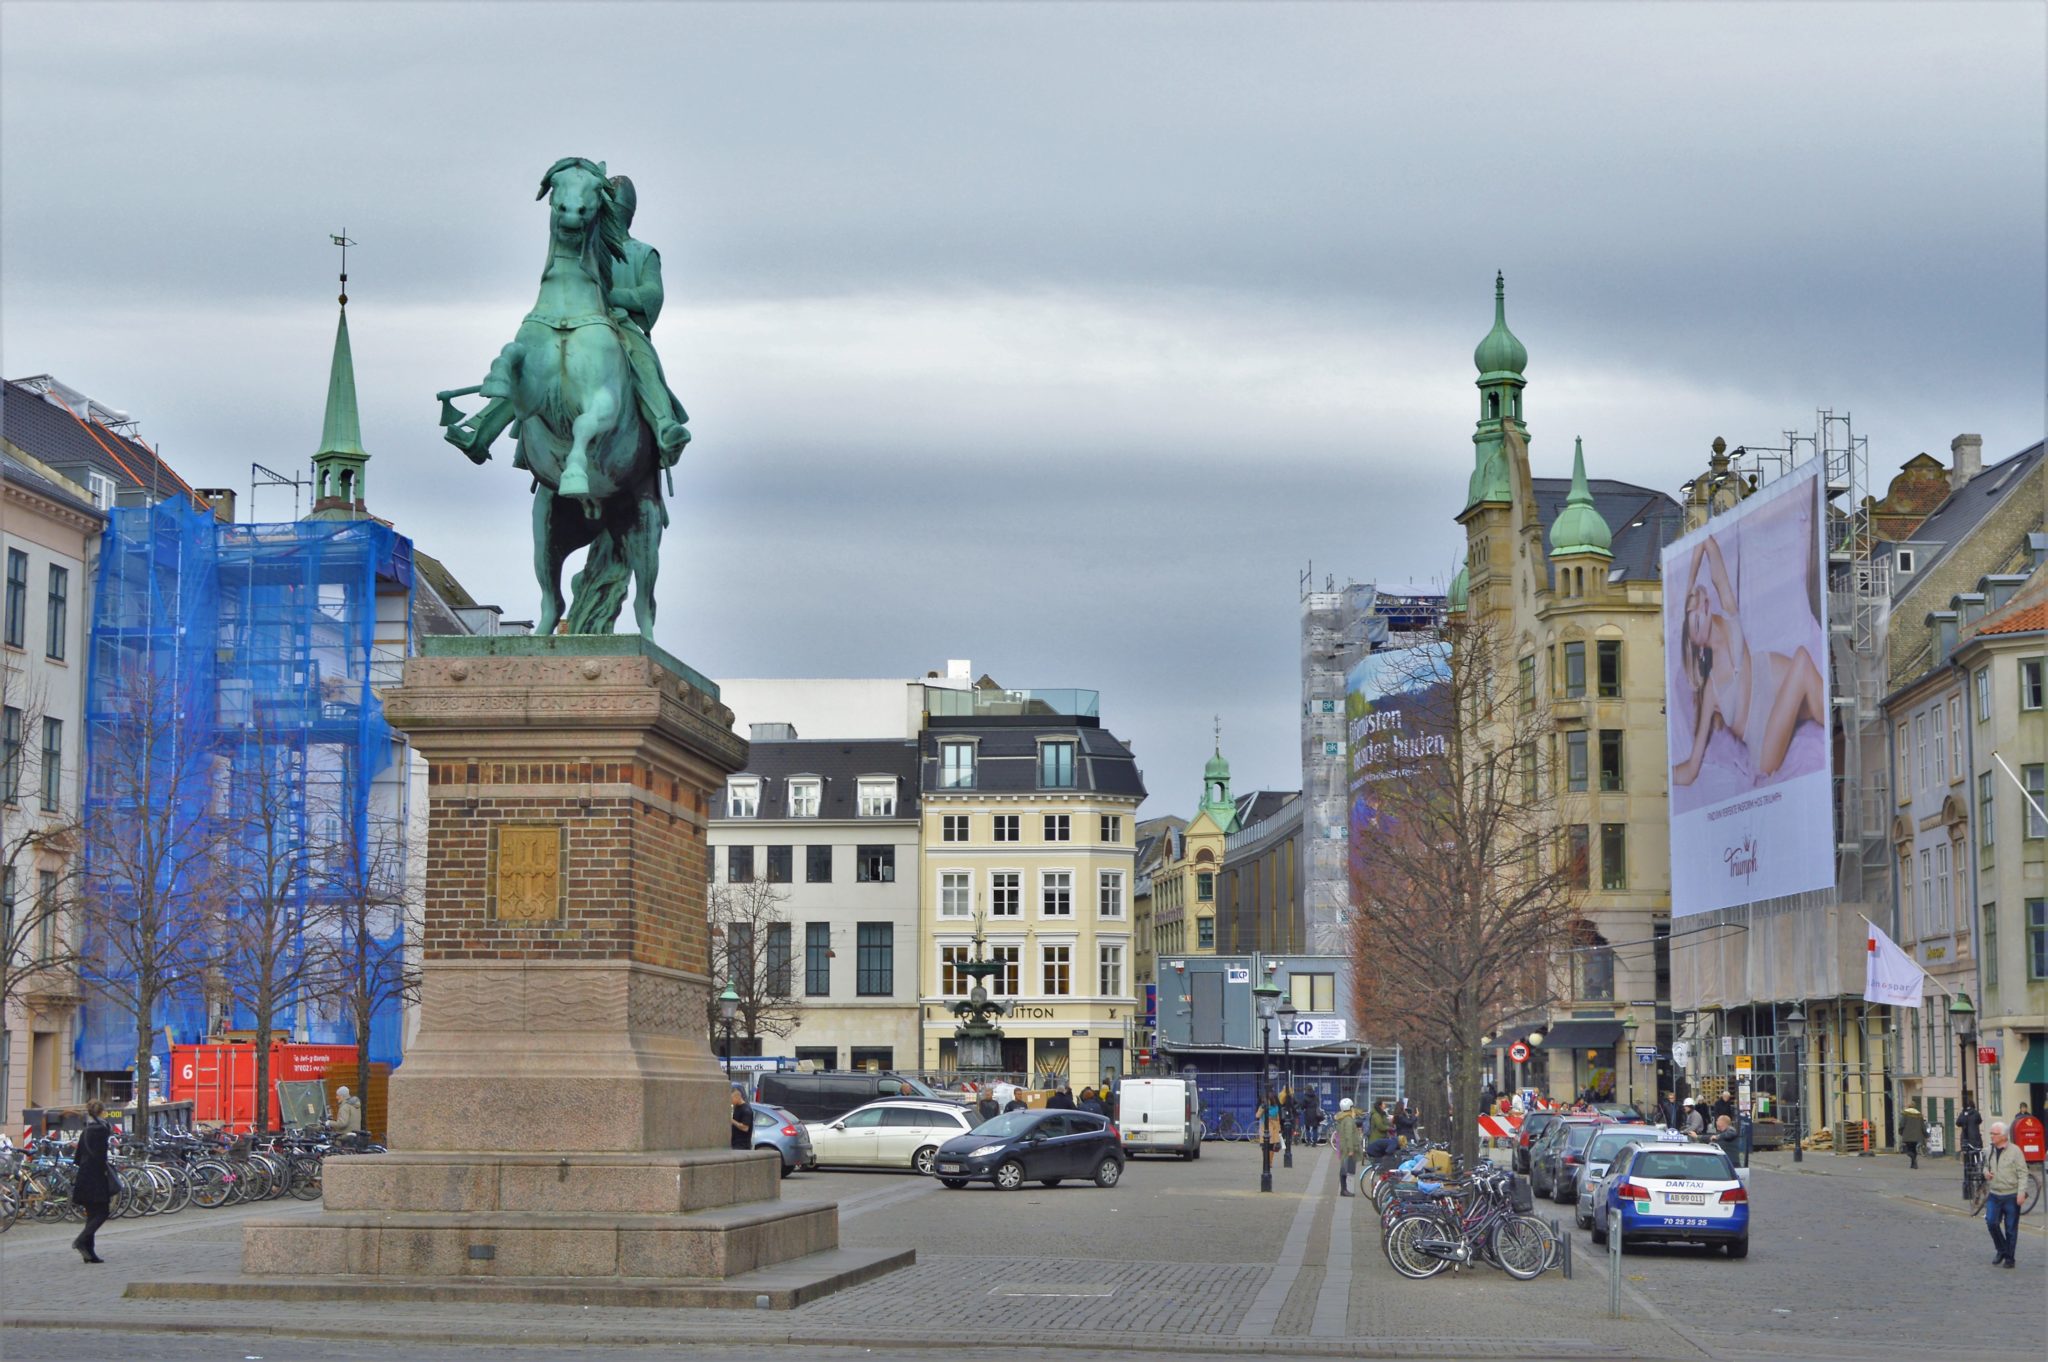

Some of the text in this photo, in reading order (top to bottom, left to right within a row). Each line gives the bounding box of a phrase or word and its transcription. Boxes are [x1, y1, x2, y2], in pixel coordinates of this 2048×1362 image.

[1723, 840, 1758, 887] Triumph
[999, 1007, 1054, 1019] UITTON
[1297, 1021, 1313, 1035] CP
[182, 1064, 193, 1080] 6
[721, 1063, 763, 1071] ww.tim.dk
